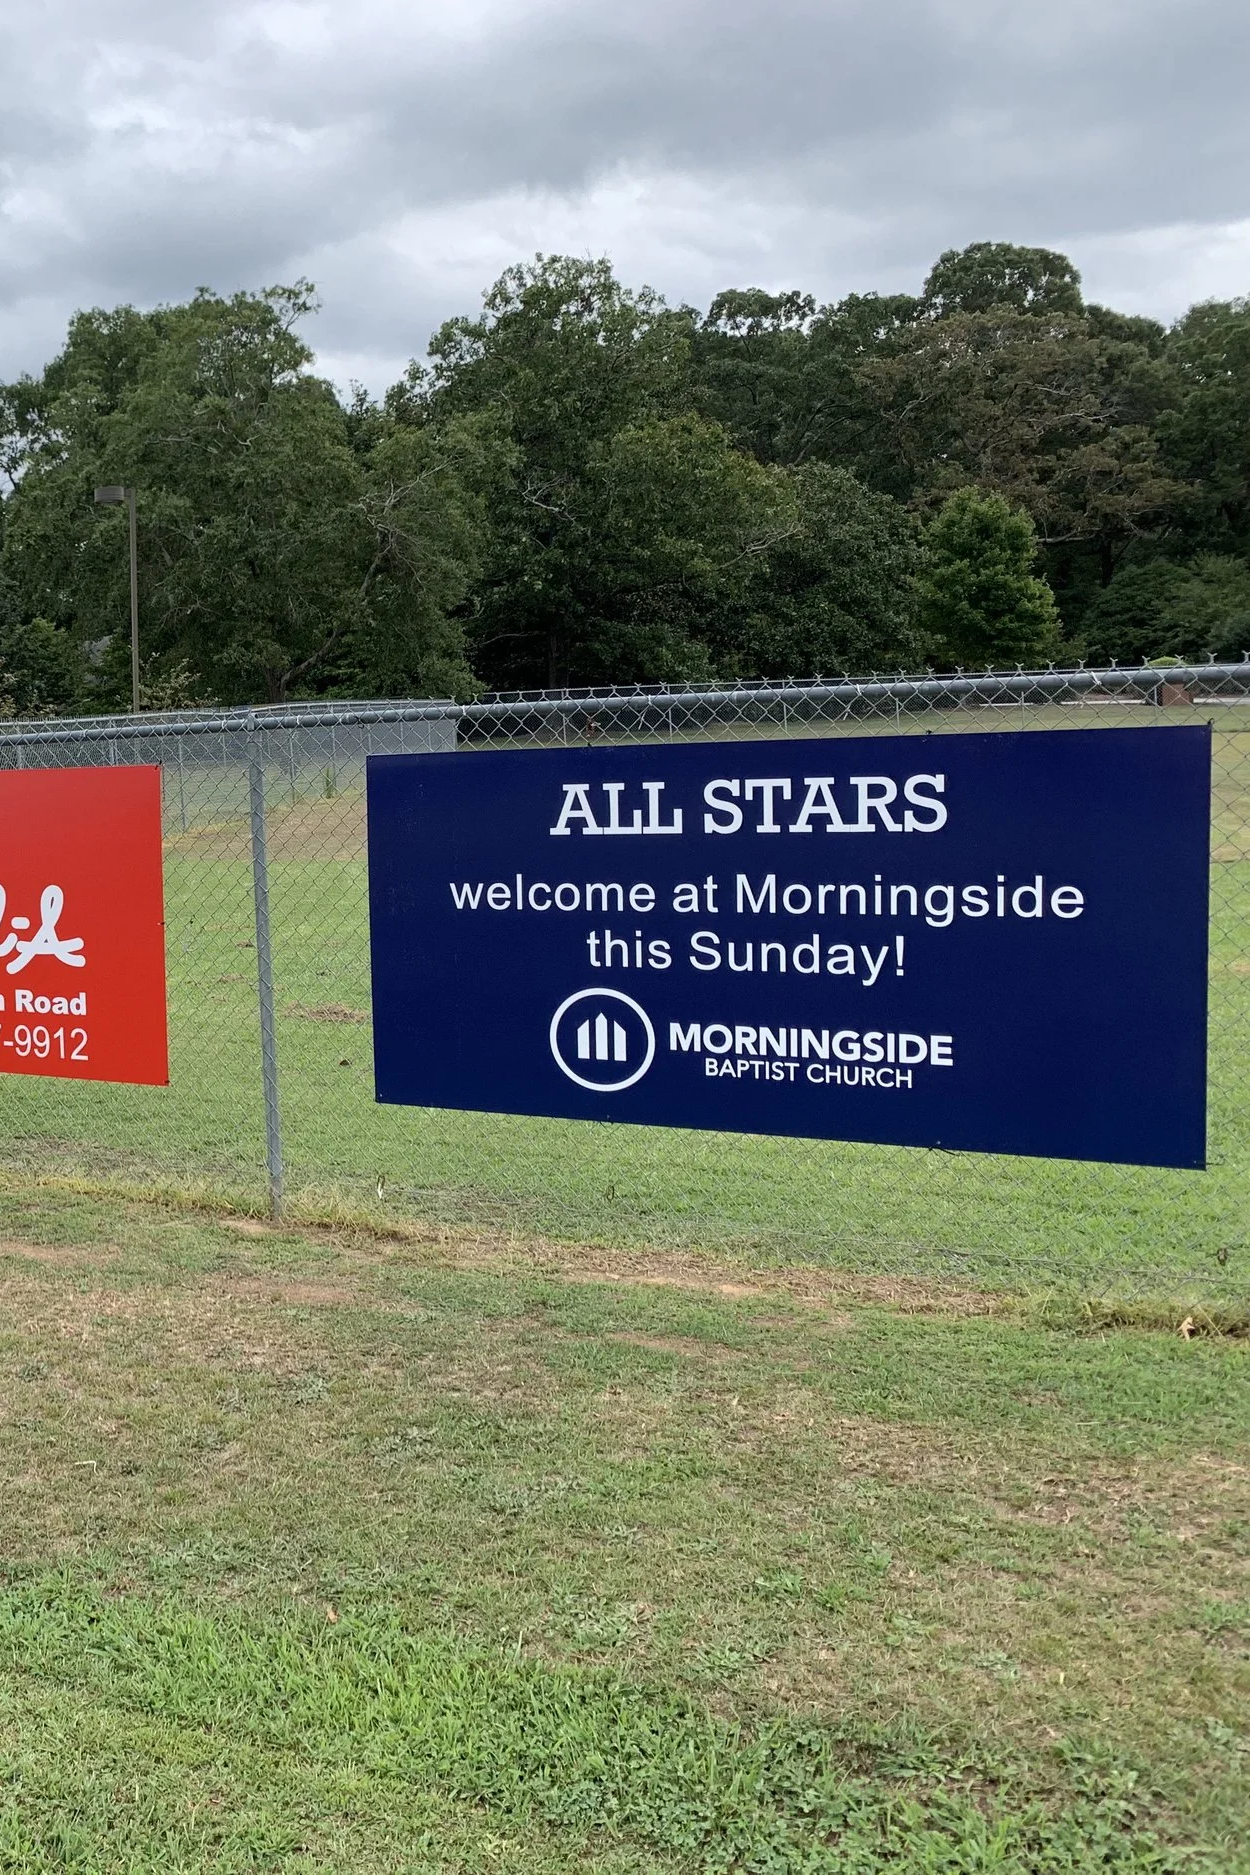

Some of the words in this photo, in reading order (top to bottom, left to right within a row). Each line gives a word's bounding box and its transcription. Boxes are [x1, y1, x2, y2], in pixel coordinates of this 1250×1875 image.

[550, 782, 683, 836] ALL
[703, 773, 948, 834] STARS
[449, 874, 656, 912] welcome
[672, 875, 719, 912] at
[736, 874, 1085, 927] Morningside
[586, 930, 672, 969] this
[689, 931, 905, 986] Sunday!
[14, 989, 87, 1016] Road
[669, 1022, 954, 1066] MORNINGSIDE
[705, 1057, 800, 1082] BAPTIST
[806, 1063, 913, 1089] CHURCH
